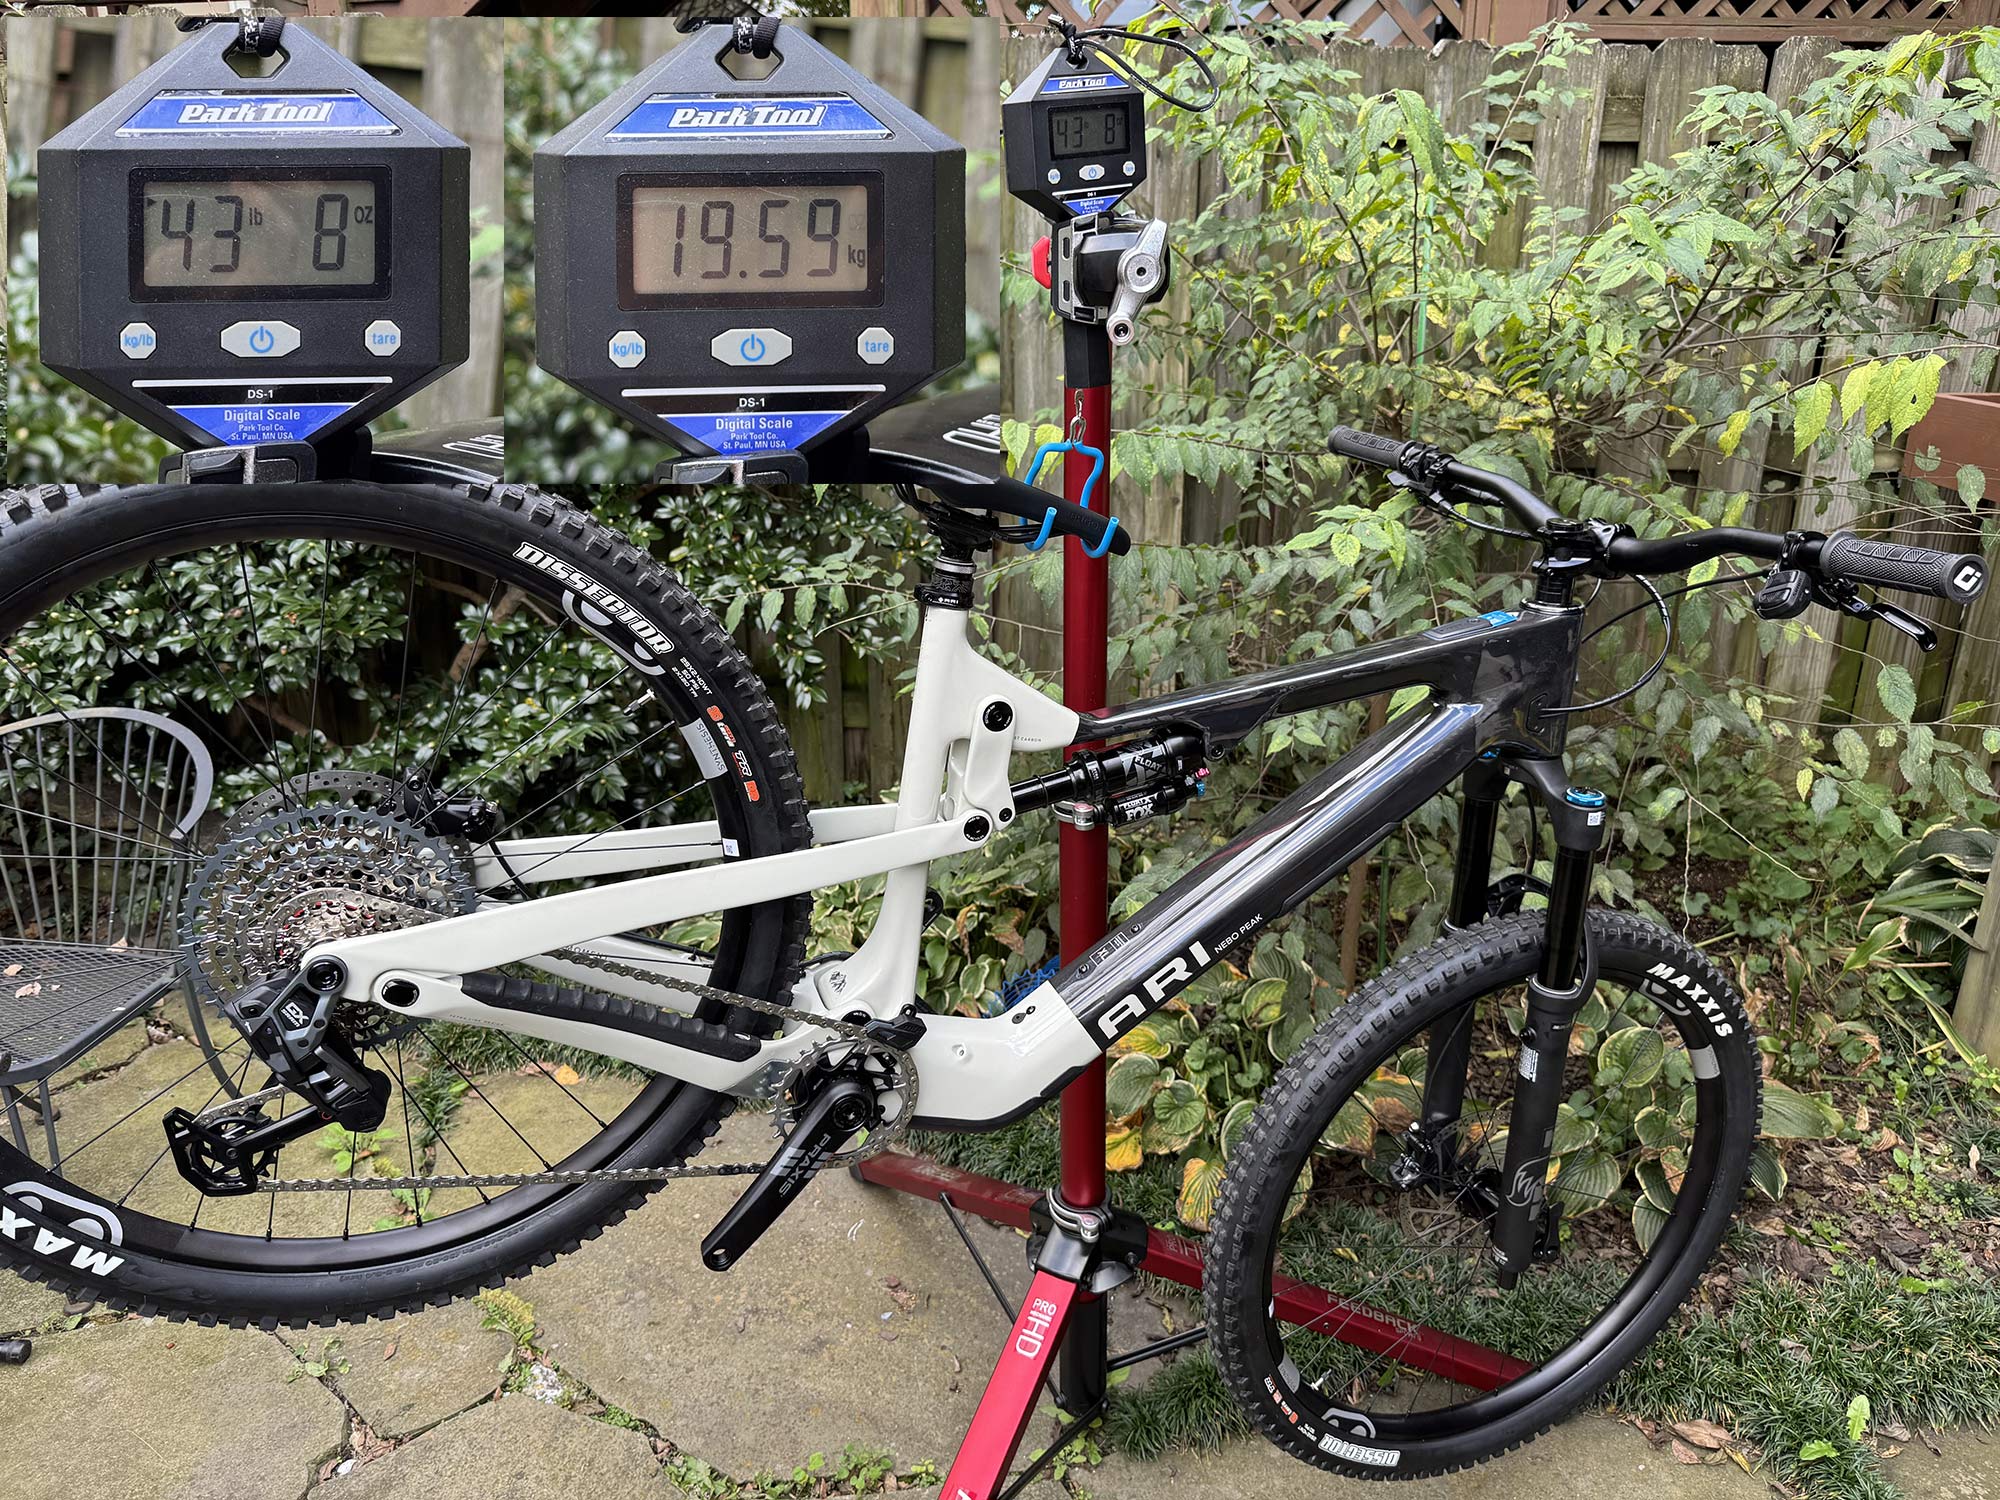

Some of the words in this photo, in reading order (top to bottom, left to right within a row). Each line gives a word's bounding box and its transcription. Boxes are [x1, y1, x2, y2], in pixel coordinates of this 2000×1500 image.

[1057, 117, 1083, 148] 43
[1105, 114, 1116, 144] 8
[249, 207, 263, 226] lb
[161, 195, 243, 272] 43
[312, 193, 349, 271] 8
[673, 199, 841, 279] 19.59
[847, 245, 866, 267] kg
[123, 332, 154, 348] kg/lb
[372, 333, 397, 345] tare
[613, 341, 643, 357] kg/lb
[864, 340, 889, 353] tare
[247, 389, 274, 399] DS-1
[739, 397, 765, 407] DS-1
[224, 409, 263, 424] Digital
[266, 408, 301, 421] Scale
[716, 417, 755, 432] Digital
[759, 416, 793, 429] Scale
[231, 432, 241, 441] St.
[242, 432, 261, 441] Paul,
[262, 432, 276, 440] MN
[277, 431, 294, 440] USA
[238, 424, 256, 432] Park
[257, 423, 273, 431] Tool
[274, 423, 286, 431] Co.
[730, 432, 748, 440] Park
[750, 432, 765, 440] Tool
[766, 431, 779, 440] Co.
[723, 441, 733, 450] St.
[734, 441, 753, 450] Paul,
[754, 441, 768, 449] MN
[770, 440, 787, 449] USA
[512, 542, 675, 654] DISSECTOR
[1134, 755, 1163, 771] FLOAT
[1125, 803, 1154, 822] FOX
[1214, 932, 1240, 954] NEBO
[1239, 913, 1263, 935] PEAK
[1097, 941, 1212, 1039] ARI
[1647, 962, 1733, 1037] MAXXIS
[285, 1002, 310, 1025] GX
[778, 1132, 832, 1197] PRAXIS
[0, 1205, 125, 1277] MAX
[1032, 1298, 1057, 1316] PRO
[1327, 1293, 1419, 1335] FEEDBACK
[1015, 1315, 1050, 1360] HD
[1317, 1433, 1401, 1467] DISSECTOR
